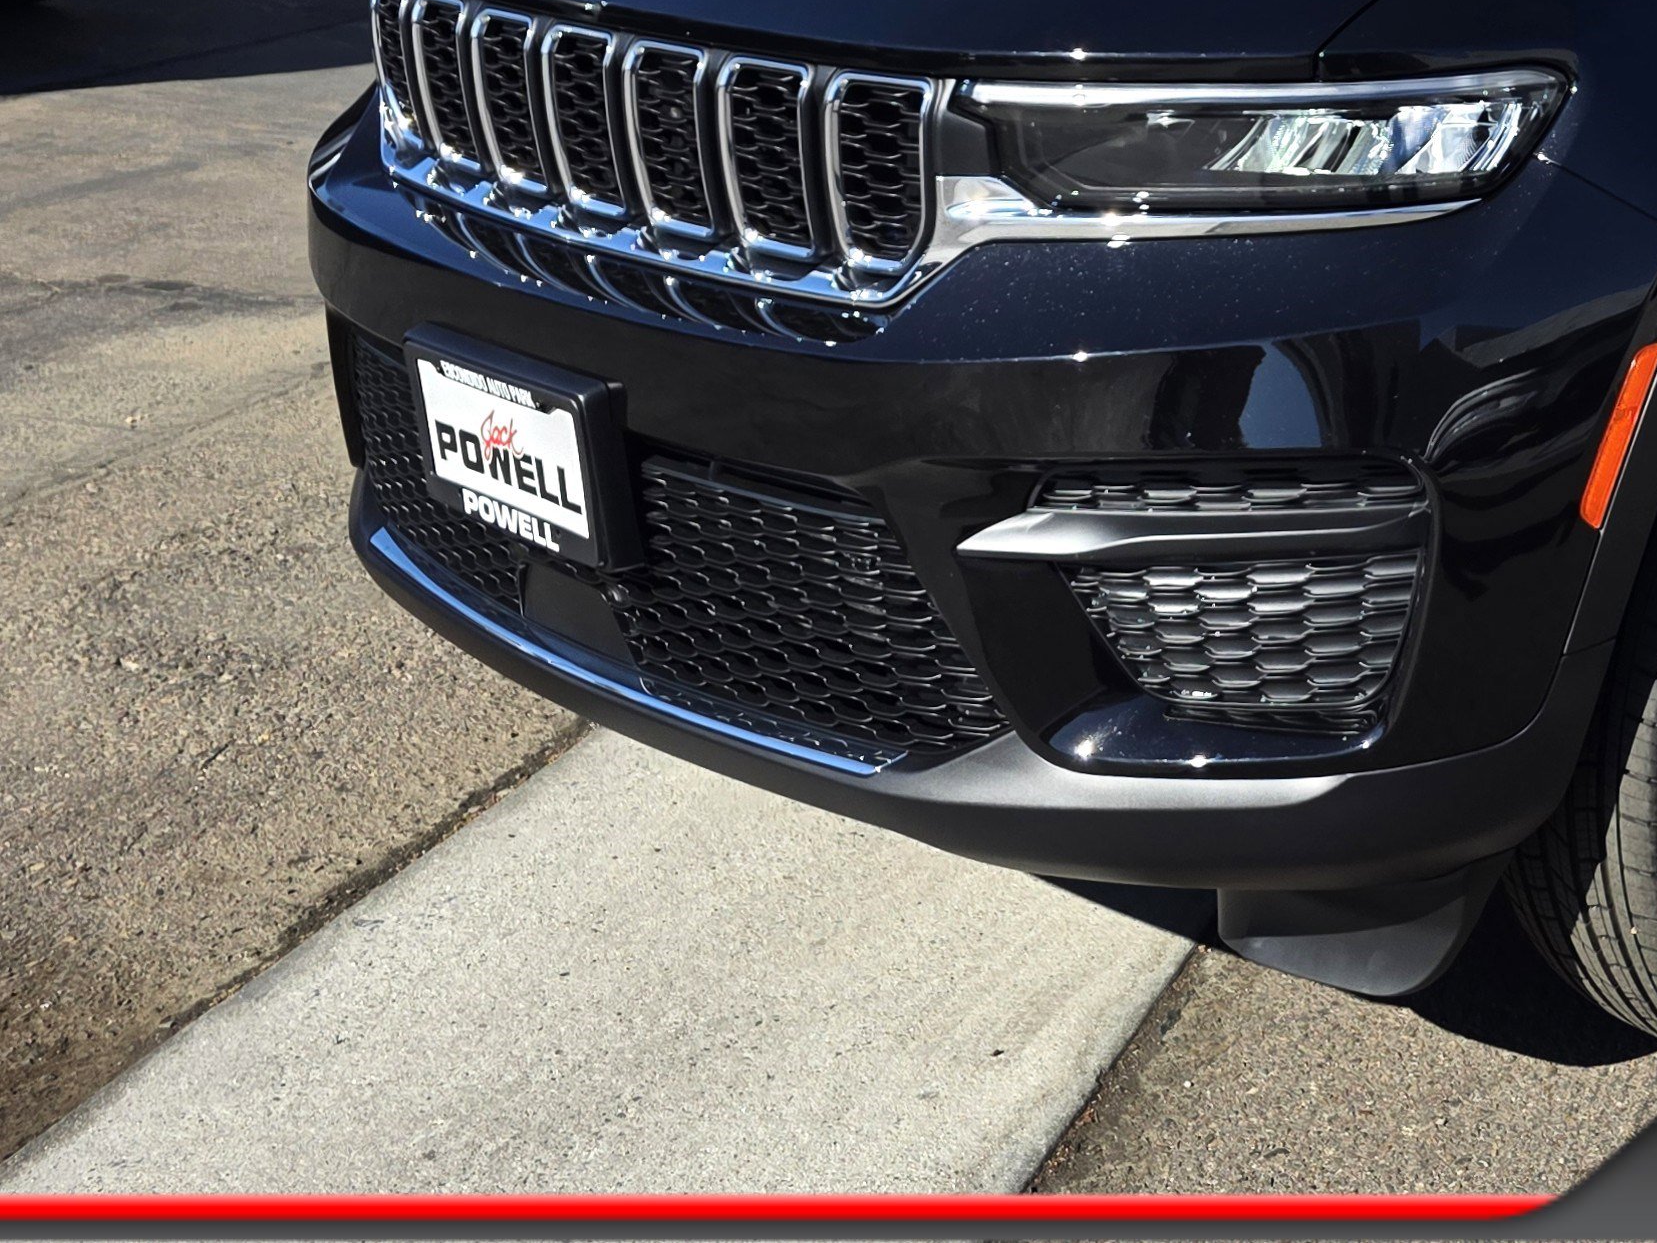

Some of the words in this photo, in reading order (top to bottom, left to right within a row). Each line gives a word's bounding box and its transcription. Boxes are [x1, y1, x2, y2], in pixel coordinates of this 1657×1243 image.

[486, 376, 512, 401] AUTO
[480, 409, 525, 462] Jack
[435, 419, 583, 516] POWELL
[461, 487, 560, 553] POWELL
